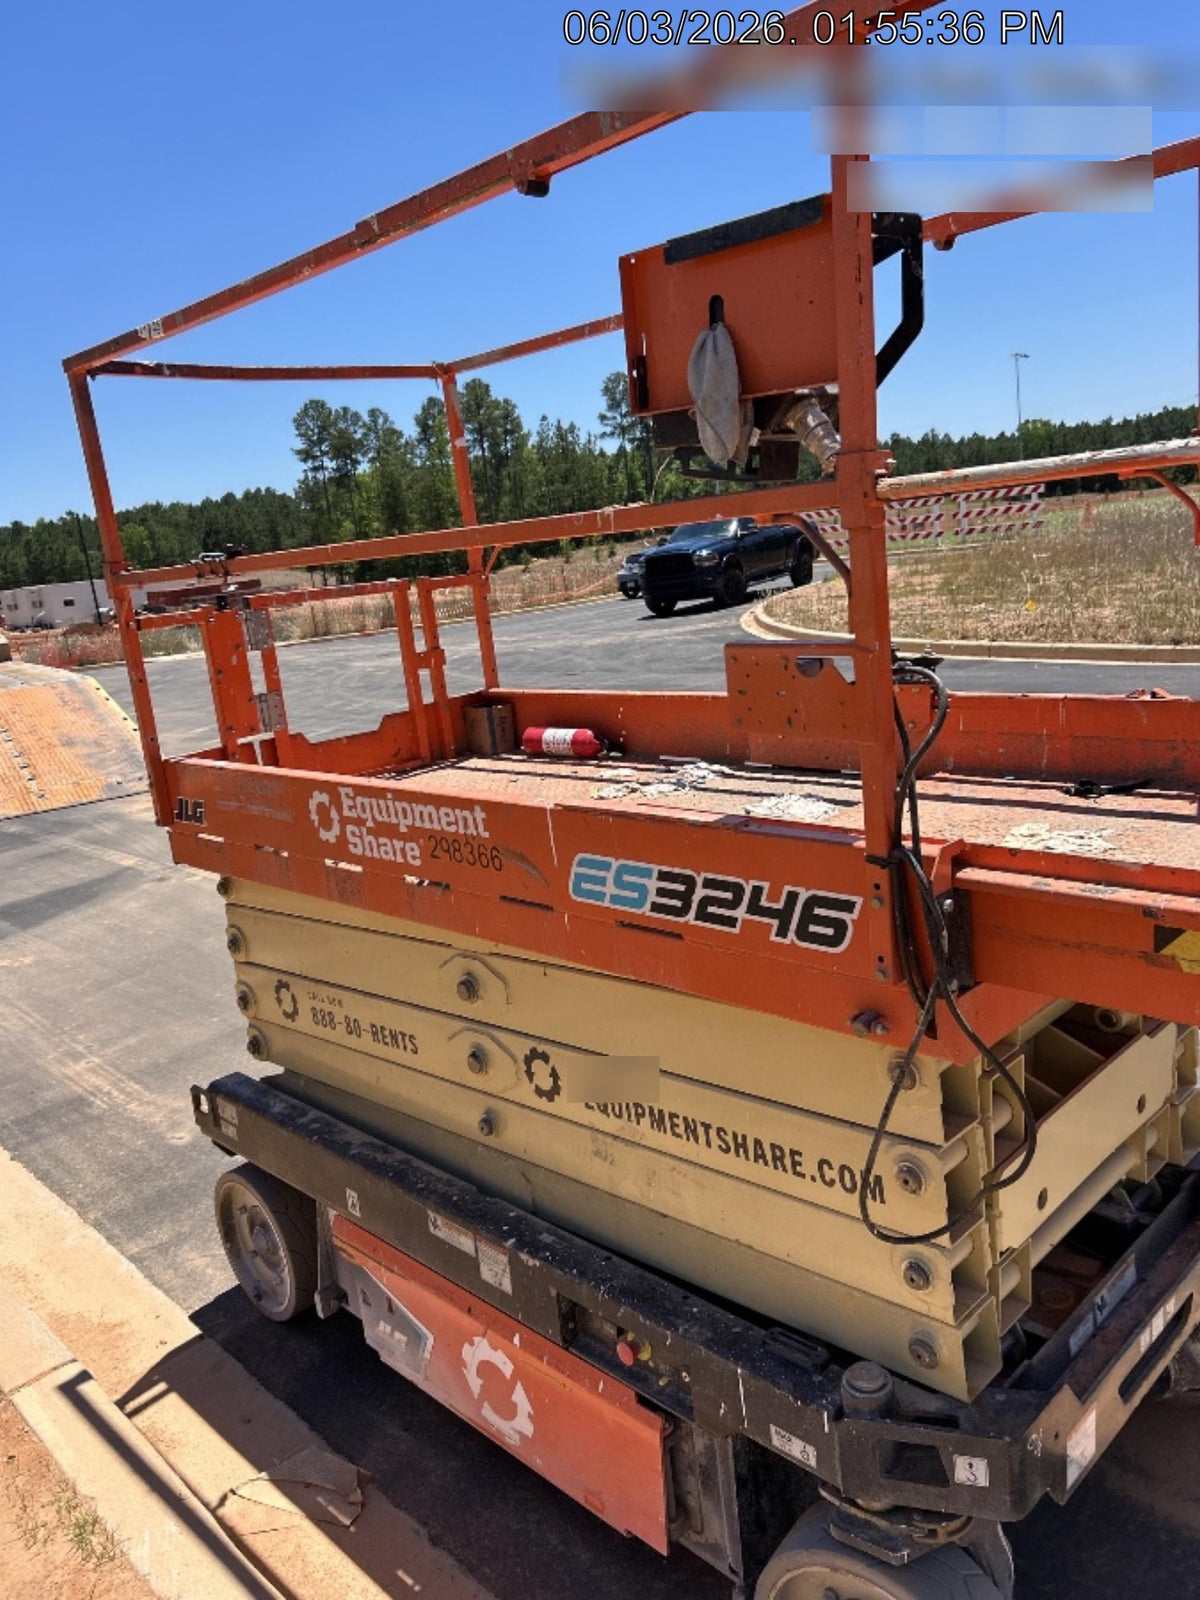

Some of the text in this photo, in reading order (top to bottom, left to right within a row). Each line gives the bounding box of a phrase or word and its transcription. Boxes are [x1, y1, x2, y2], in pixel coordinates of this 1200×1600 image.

[174, 796, 207, 827] JLG
[339, 787, 489, 838] Equipment
[347, 825, 421, 866] Share
[428, 834, 503, 872] 298366
[569, 853, 863, 953] ES3246
[310, 1006, 419, 1055] 888-80-RENTS
